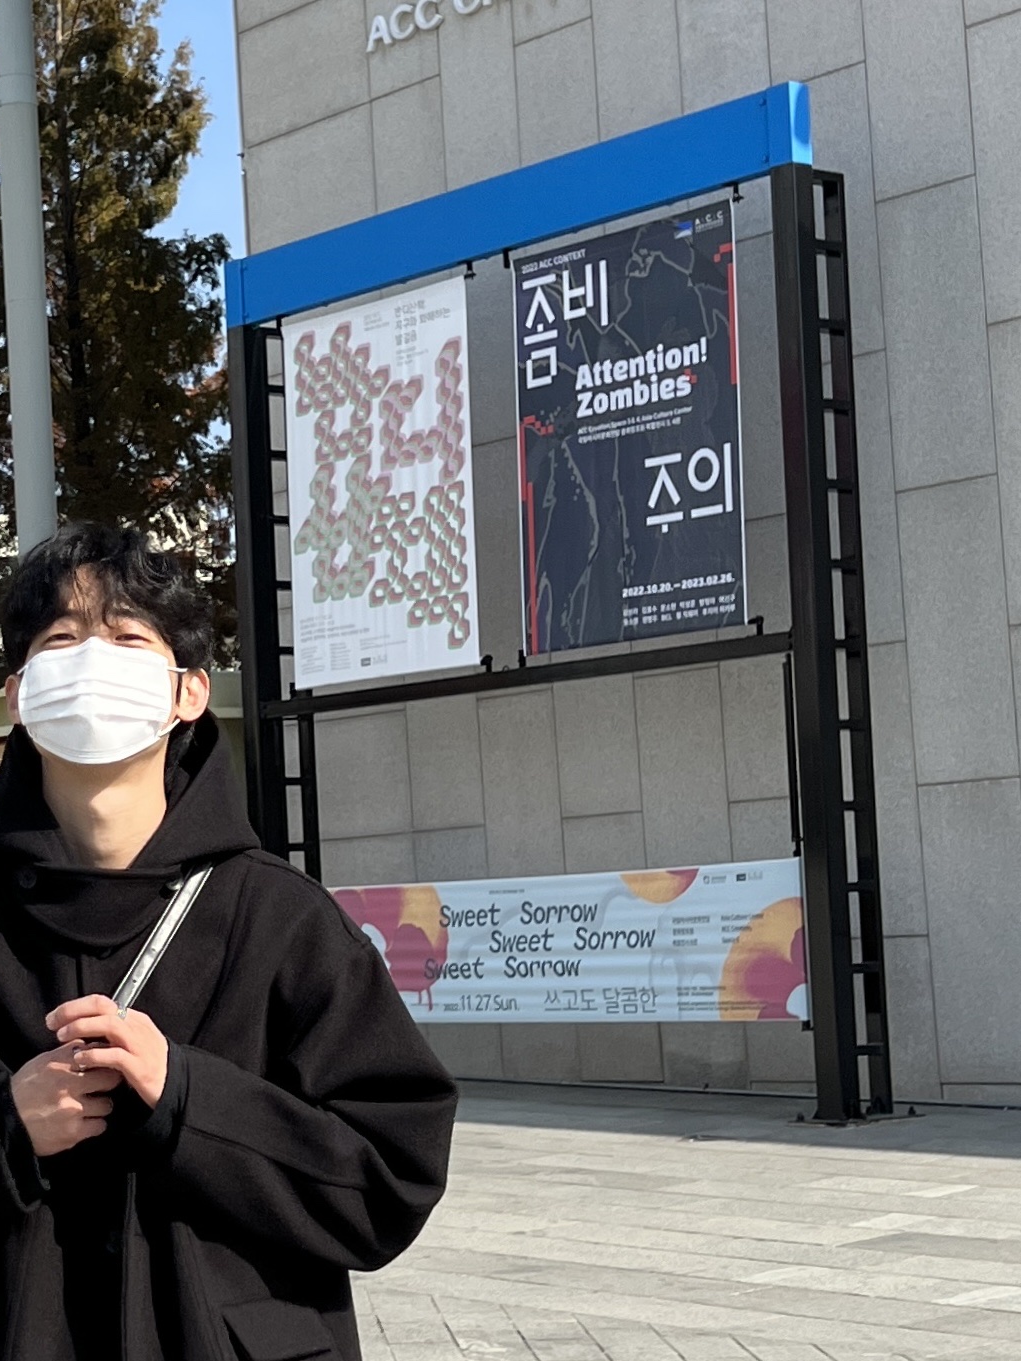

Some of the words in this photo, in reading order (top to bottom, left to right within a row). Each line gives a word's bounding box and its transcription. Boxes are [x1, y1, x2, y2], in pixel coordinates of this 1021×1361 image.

[366, 0, 444, 53] ACC
[539, 256, 553, 270] ACC
[553, 248, 586, 266] CONTEXT
[522, 259, 609, 390] 좀비
[575, 336, 708, 392] Attention!
[576, 373, 693, 419] Zombies
[644, 442, 734, 534] 주의
[438, 902, 501, 928] Sweet
[520, 900, 598, 925] Sorrow
[488, 928, 555, 954] Sweet
[573, 926, 656, 951] Sorrow
[423, 956, 485, 980] Sweet
[503, 955, 582, 979] Sorrow
[543, 988, 598, 1012] 쓰고도
[602, 986, 659, 1015] 달콤한
